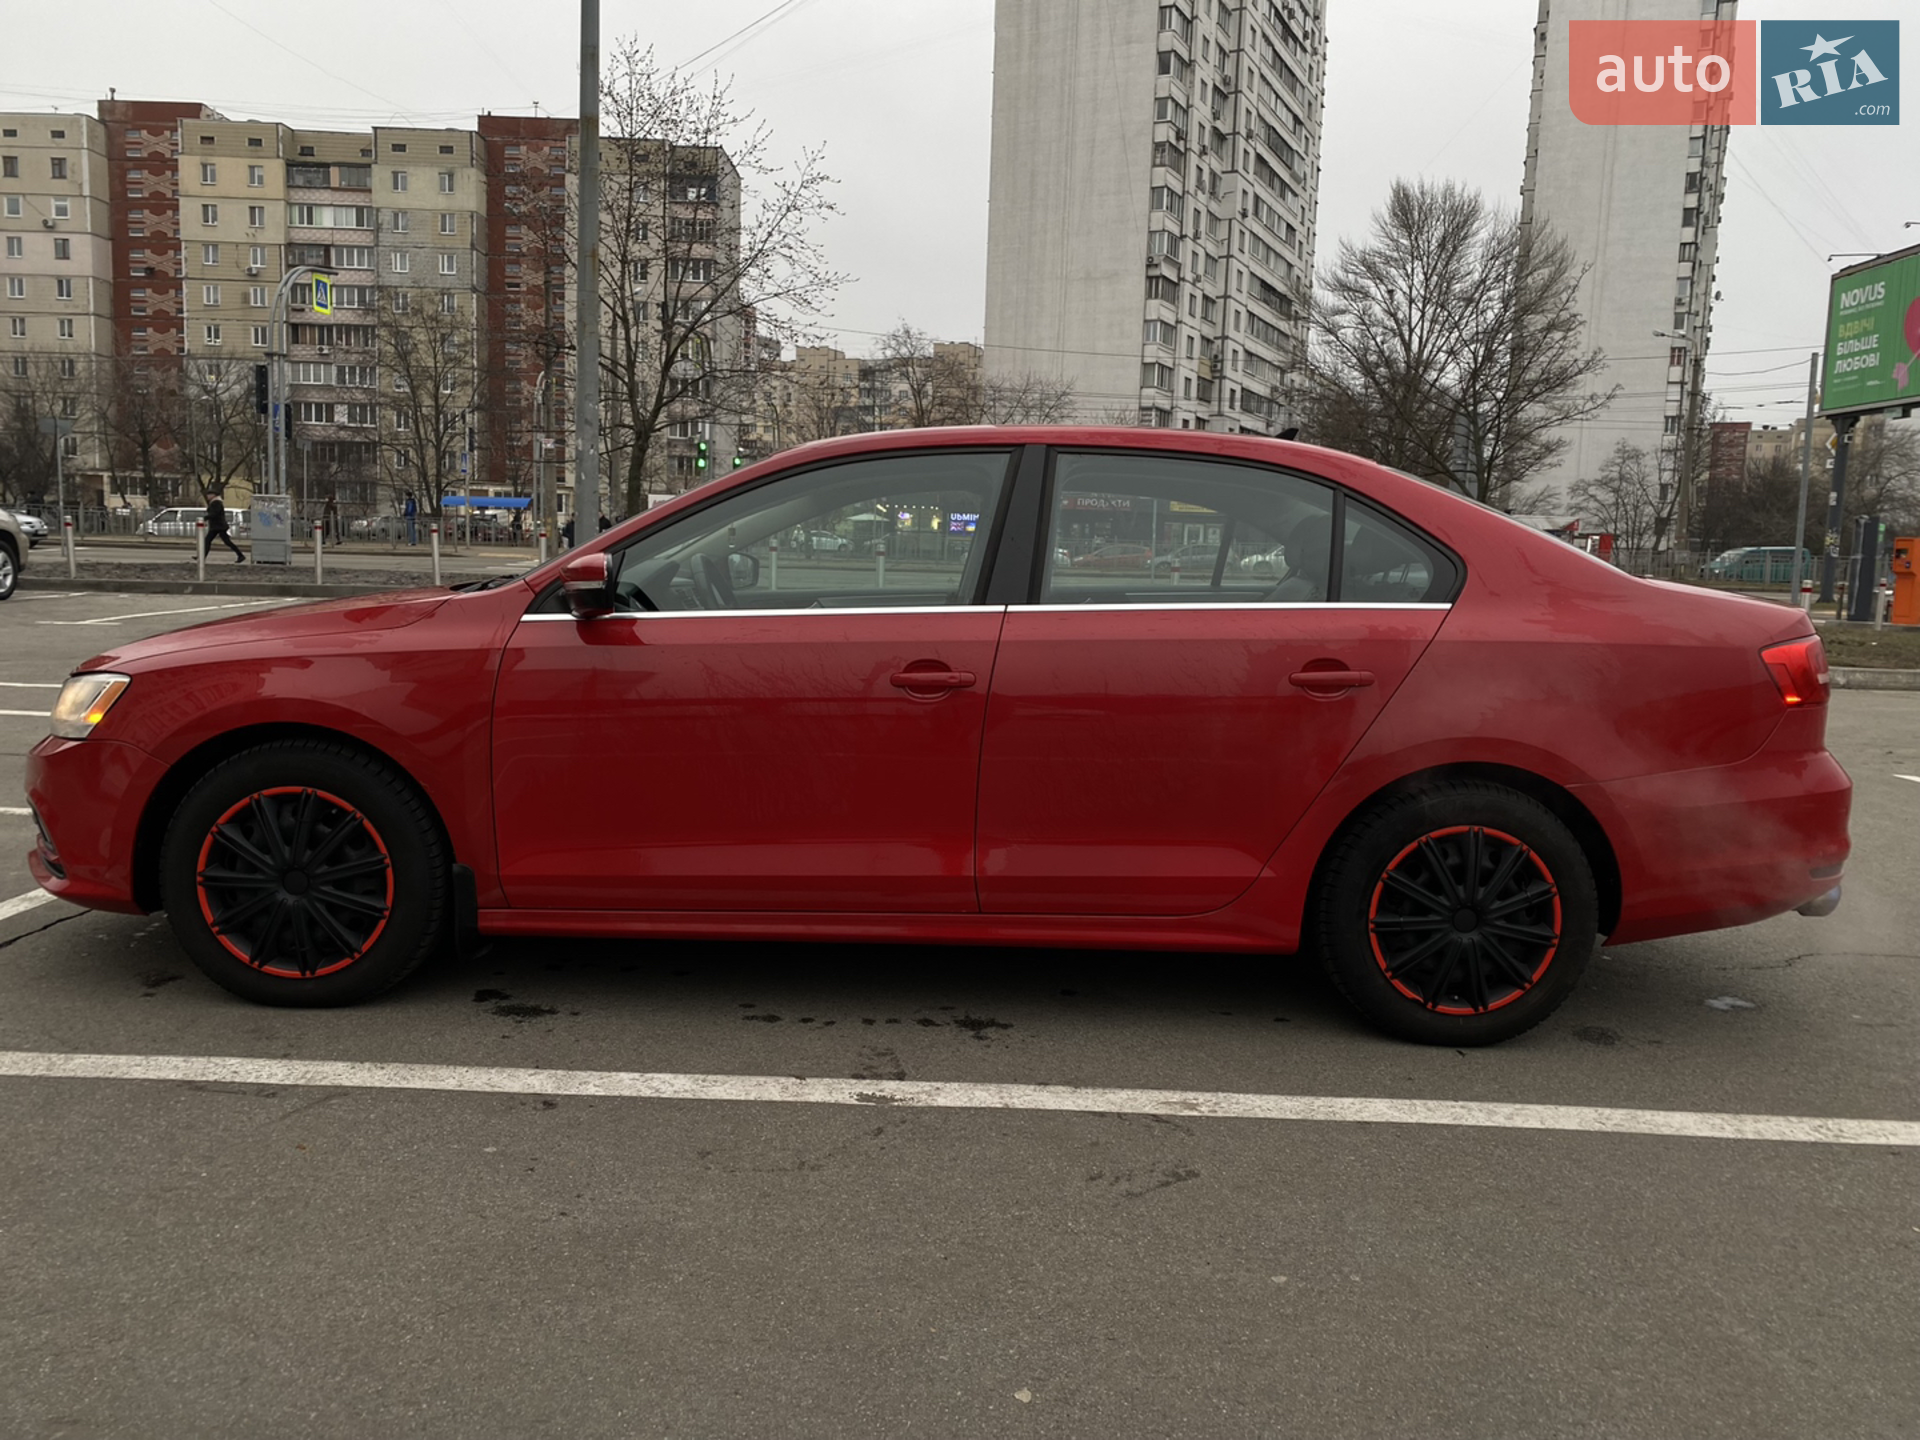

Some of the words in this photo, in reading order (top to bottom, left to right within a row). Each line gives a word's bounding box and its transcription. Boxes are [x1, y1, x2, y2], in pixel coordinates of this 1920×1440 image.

[1840, 281, 1885, 309] NOVUS
[1838, 317, 1875, 339] ВДВІЧІ
[1837, 334, 1879, 356] БІЛЬШЕ
[1834, 352, 1880, 374] ЛЮБОВІ
